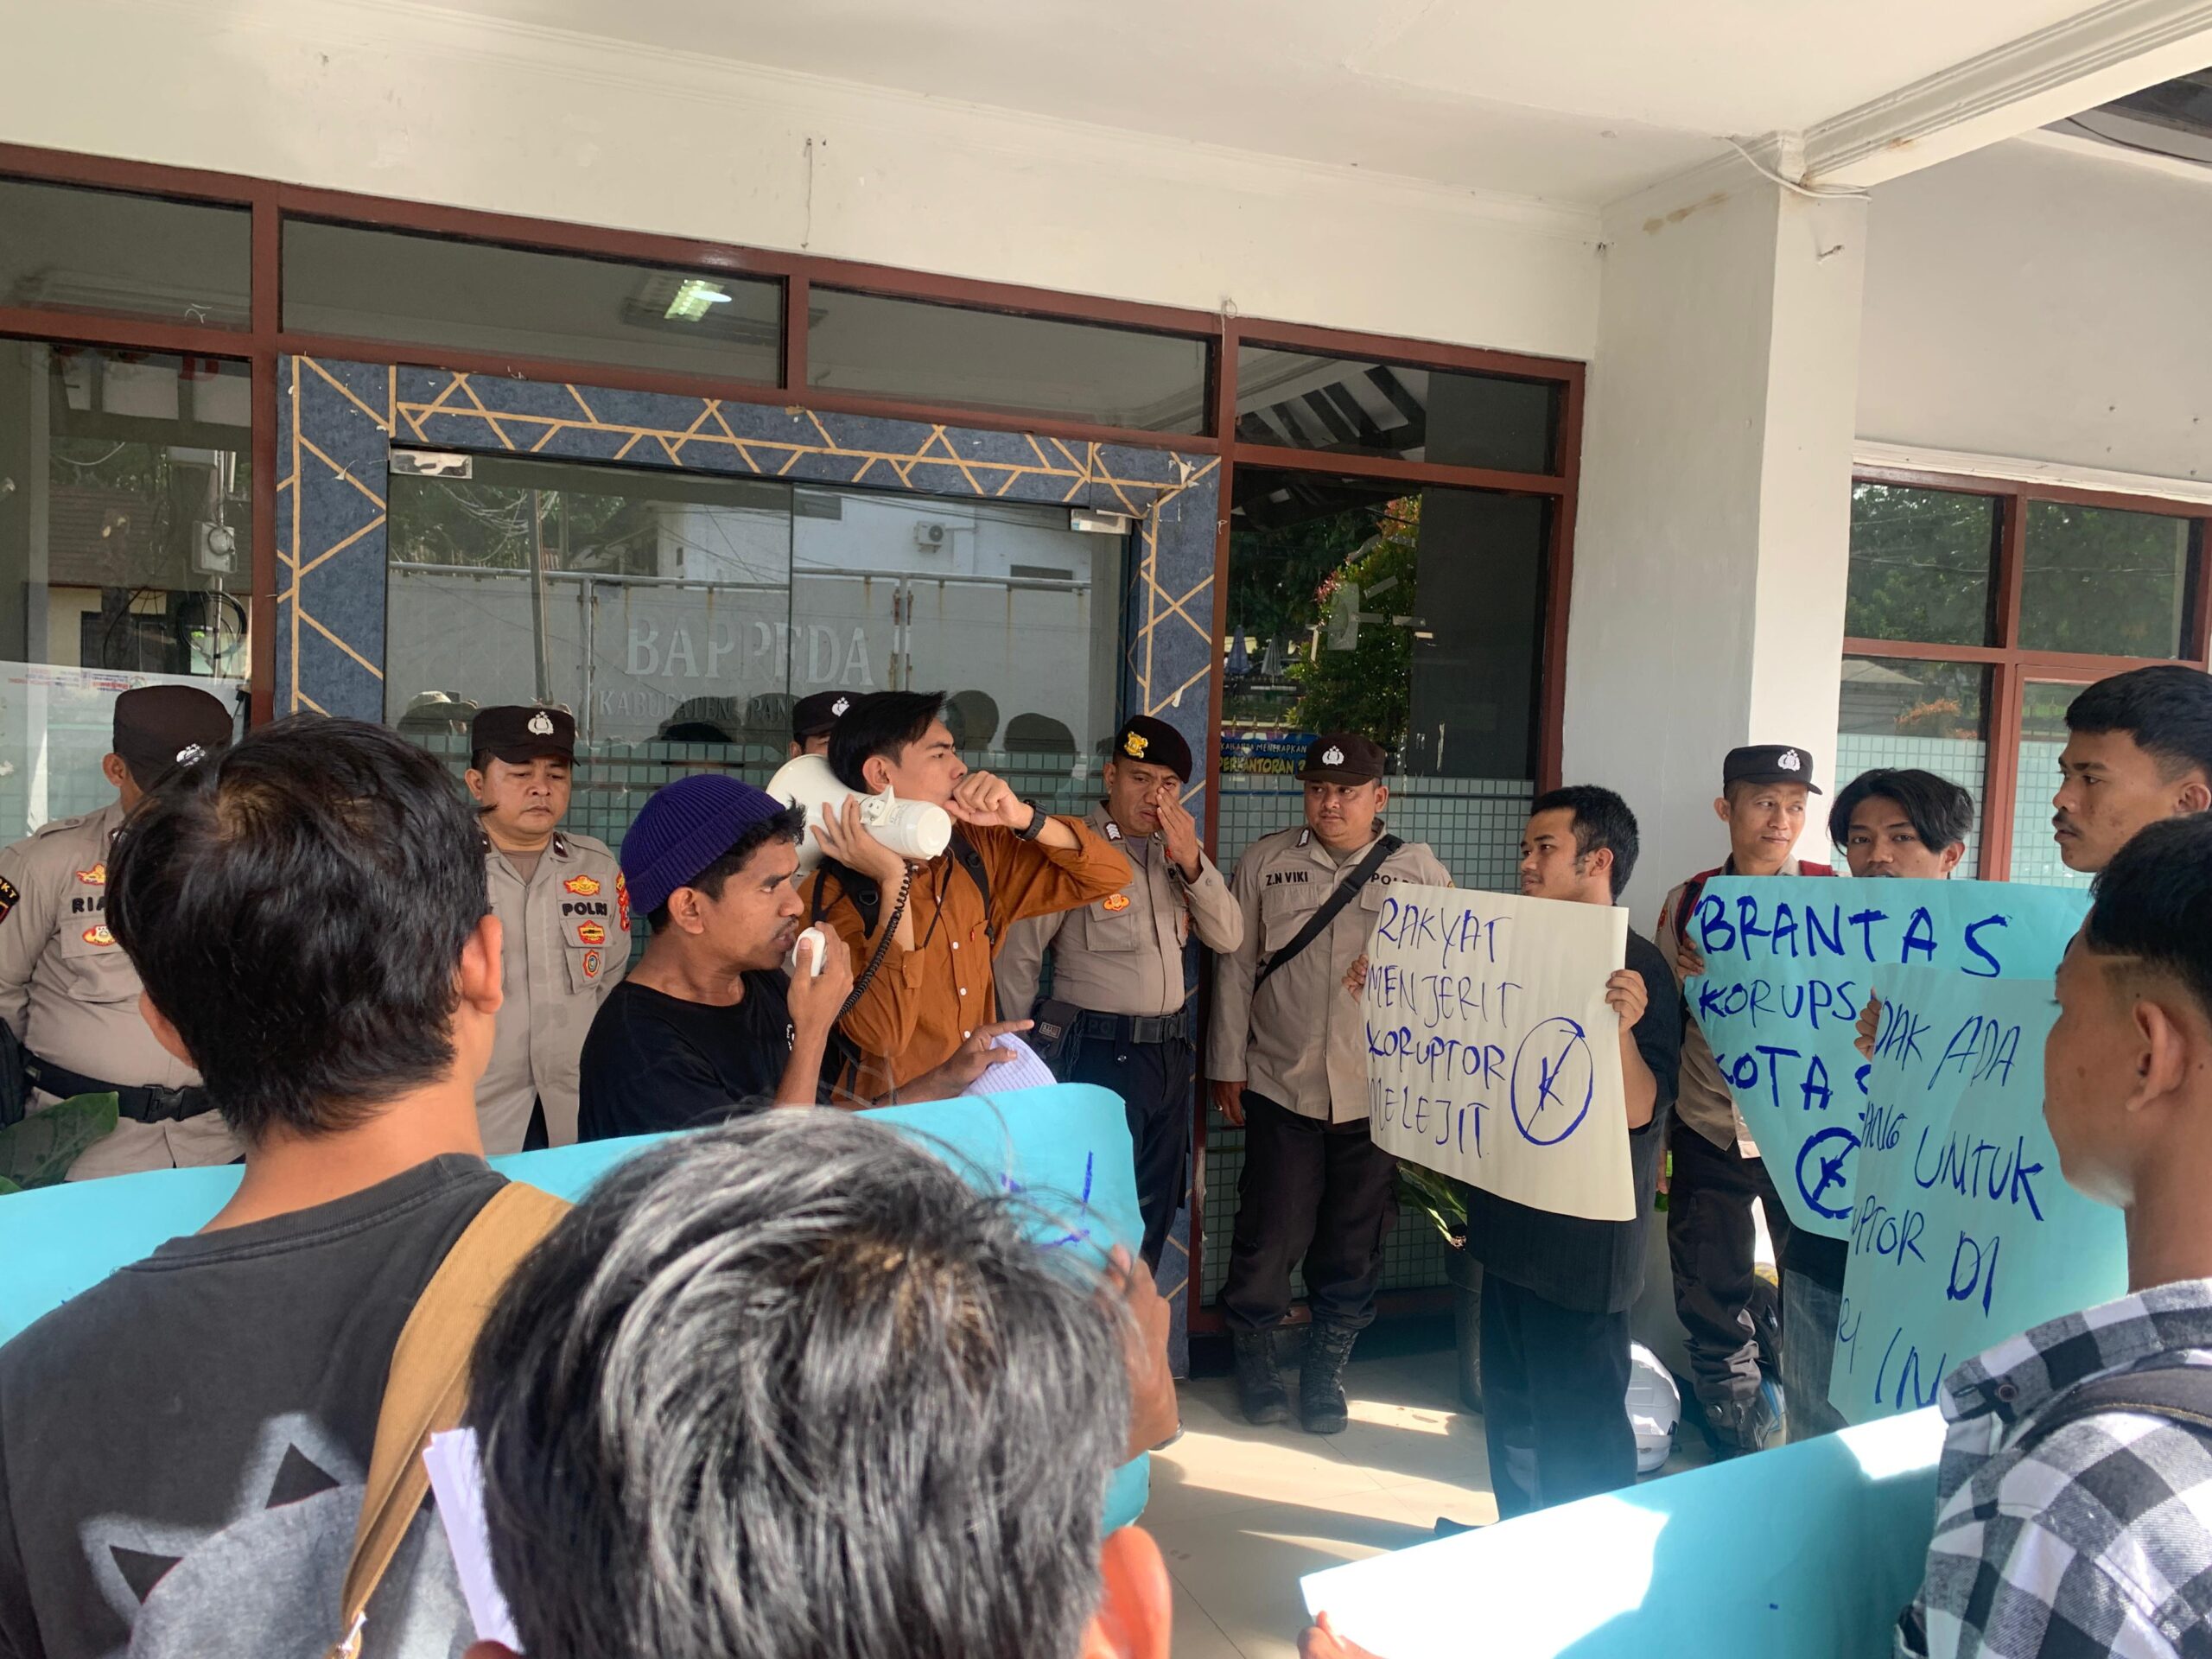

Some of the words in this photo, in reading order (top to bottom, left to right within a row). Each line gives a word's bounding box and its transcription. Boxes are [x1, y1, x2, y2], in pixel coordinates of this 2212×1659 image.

[625, 615, 875, 687] BAPPEDA
[1255, 742, 1307, 754] MENERAPKAN
[562, 901, 608, 917] POLRI
[1284, 871, 1309, 883] VIKI
[1376, 897, 1513, 970] RAKYAT
[1694, 893, 2012, 979] BRANTAS
[1367, 963, 1524, 1029] MENJERIT
[1699, 979, 1858, 1030] KORUPS
[1365, 1019, 1507, 1090] KORUPTOR
[1873, 995, 1931, 1072] DAK
[1927, 1015, 2021, 1091] ADA
[1366, 1077, 1491, 1160] MELEJIT
[1861, 1100, 1909, 1152] ANG
[1913, 1124, 2045, 1222] UNTUK
[1946, 1230, 2000, 1319] DI
[1874, 1326, 1947, 1410] IN
